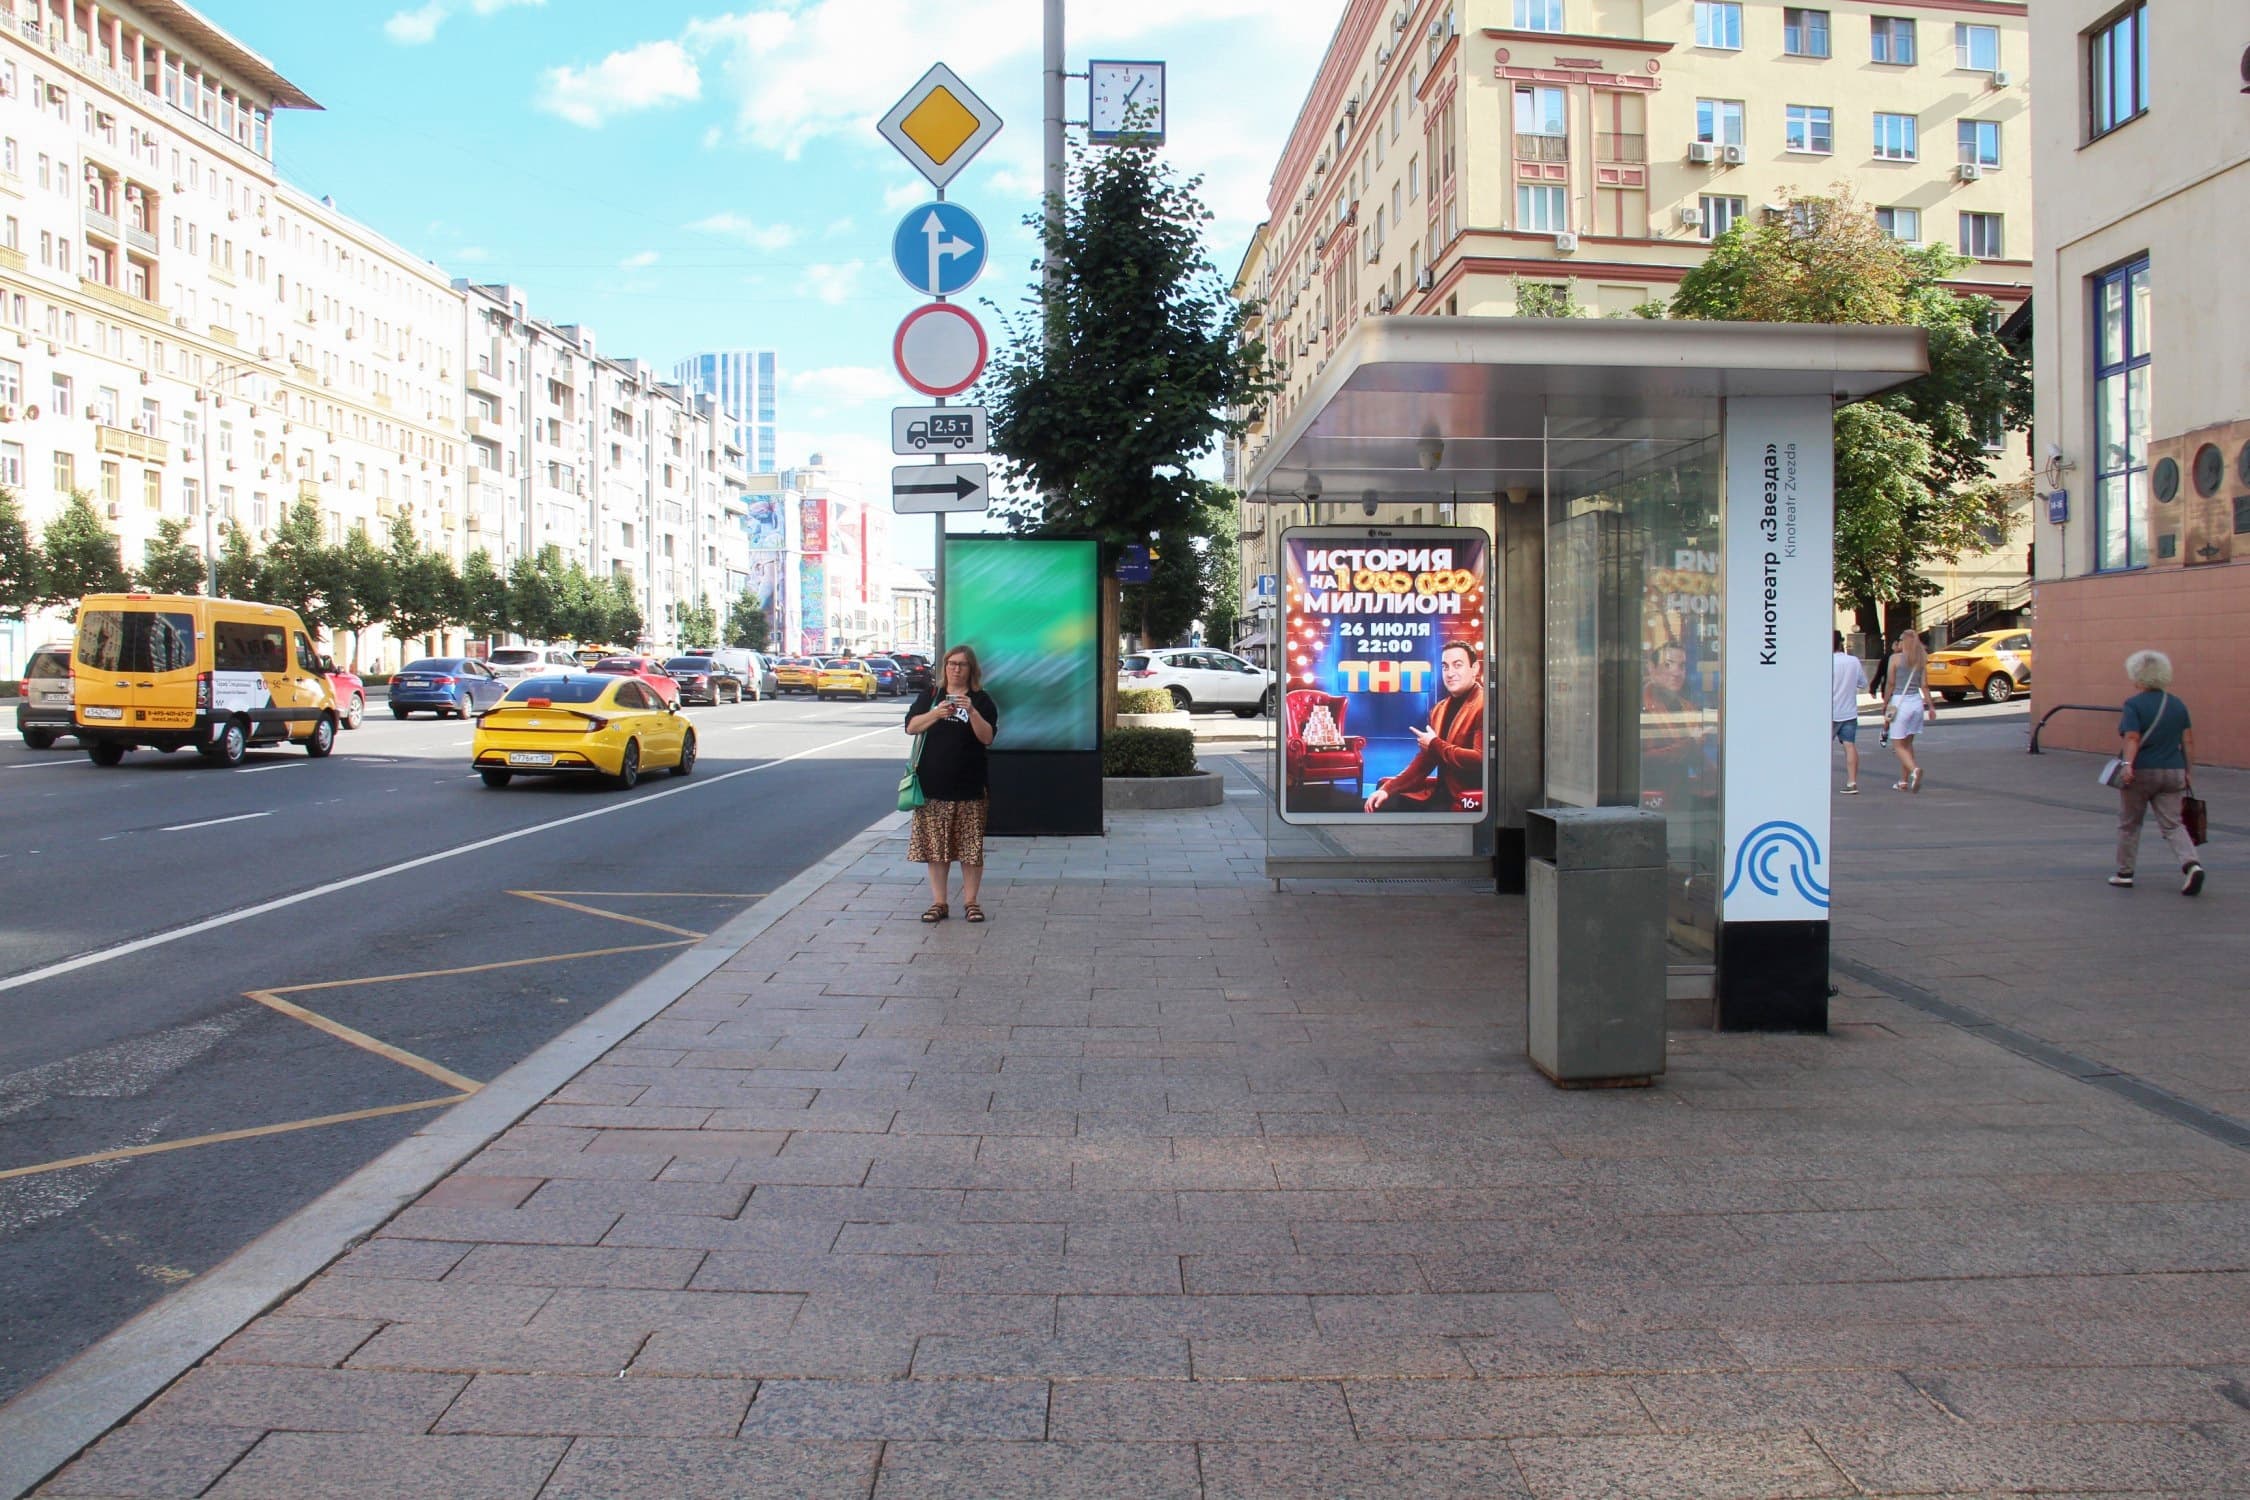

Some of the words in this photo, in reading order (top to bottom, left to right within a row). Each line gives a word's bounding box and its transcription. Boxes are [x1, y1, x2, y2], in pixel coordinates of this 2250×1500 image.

[935, 420, 956, 433] 2,5
[1784, 443, 1796, 491] Zvezda
[1760, 443, 1780, 542] «Звезда»
[1784, 494, 1796, 558] Kinoteatr
[1306, 549, 1453, 572] ИСТОРИЯ
[1310, 575, 1337, 590] НА
[1304, 592, 1461, 614] МИЛЛИОН
[1760, 552, 1781, 665] Кинотеатр
[1340, 623, 1364, 637] 26
[1371, 622, 1430, 637] ИЮЛЯ
[1357, 640, 1413, 653] 22:00
[1338, 660, 1432, 693] ТНТ
[1461, 797, 1480, 809] 16+
